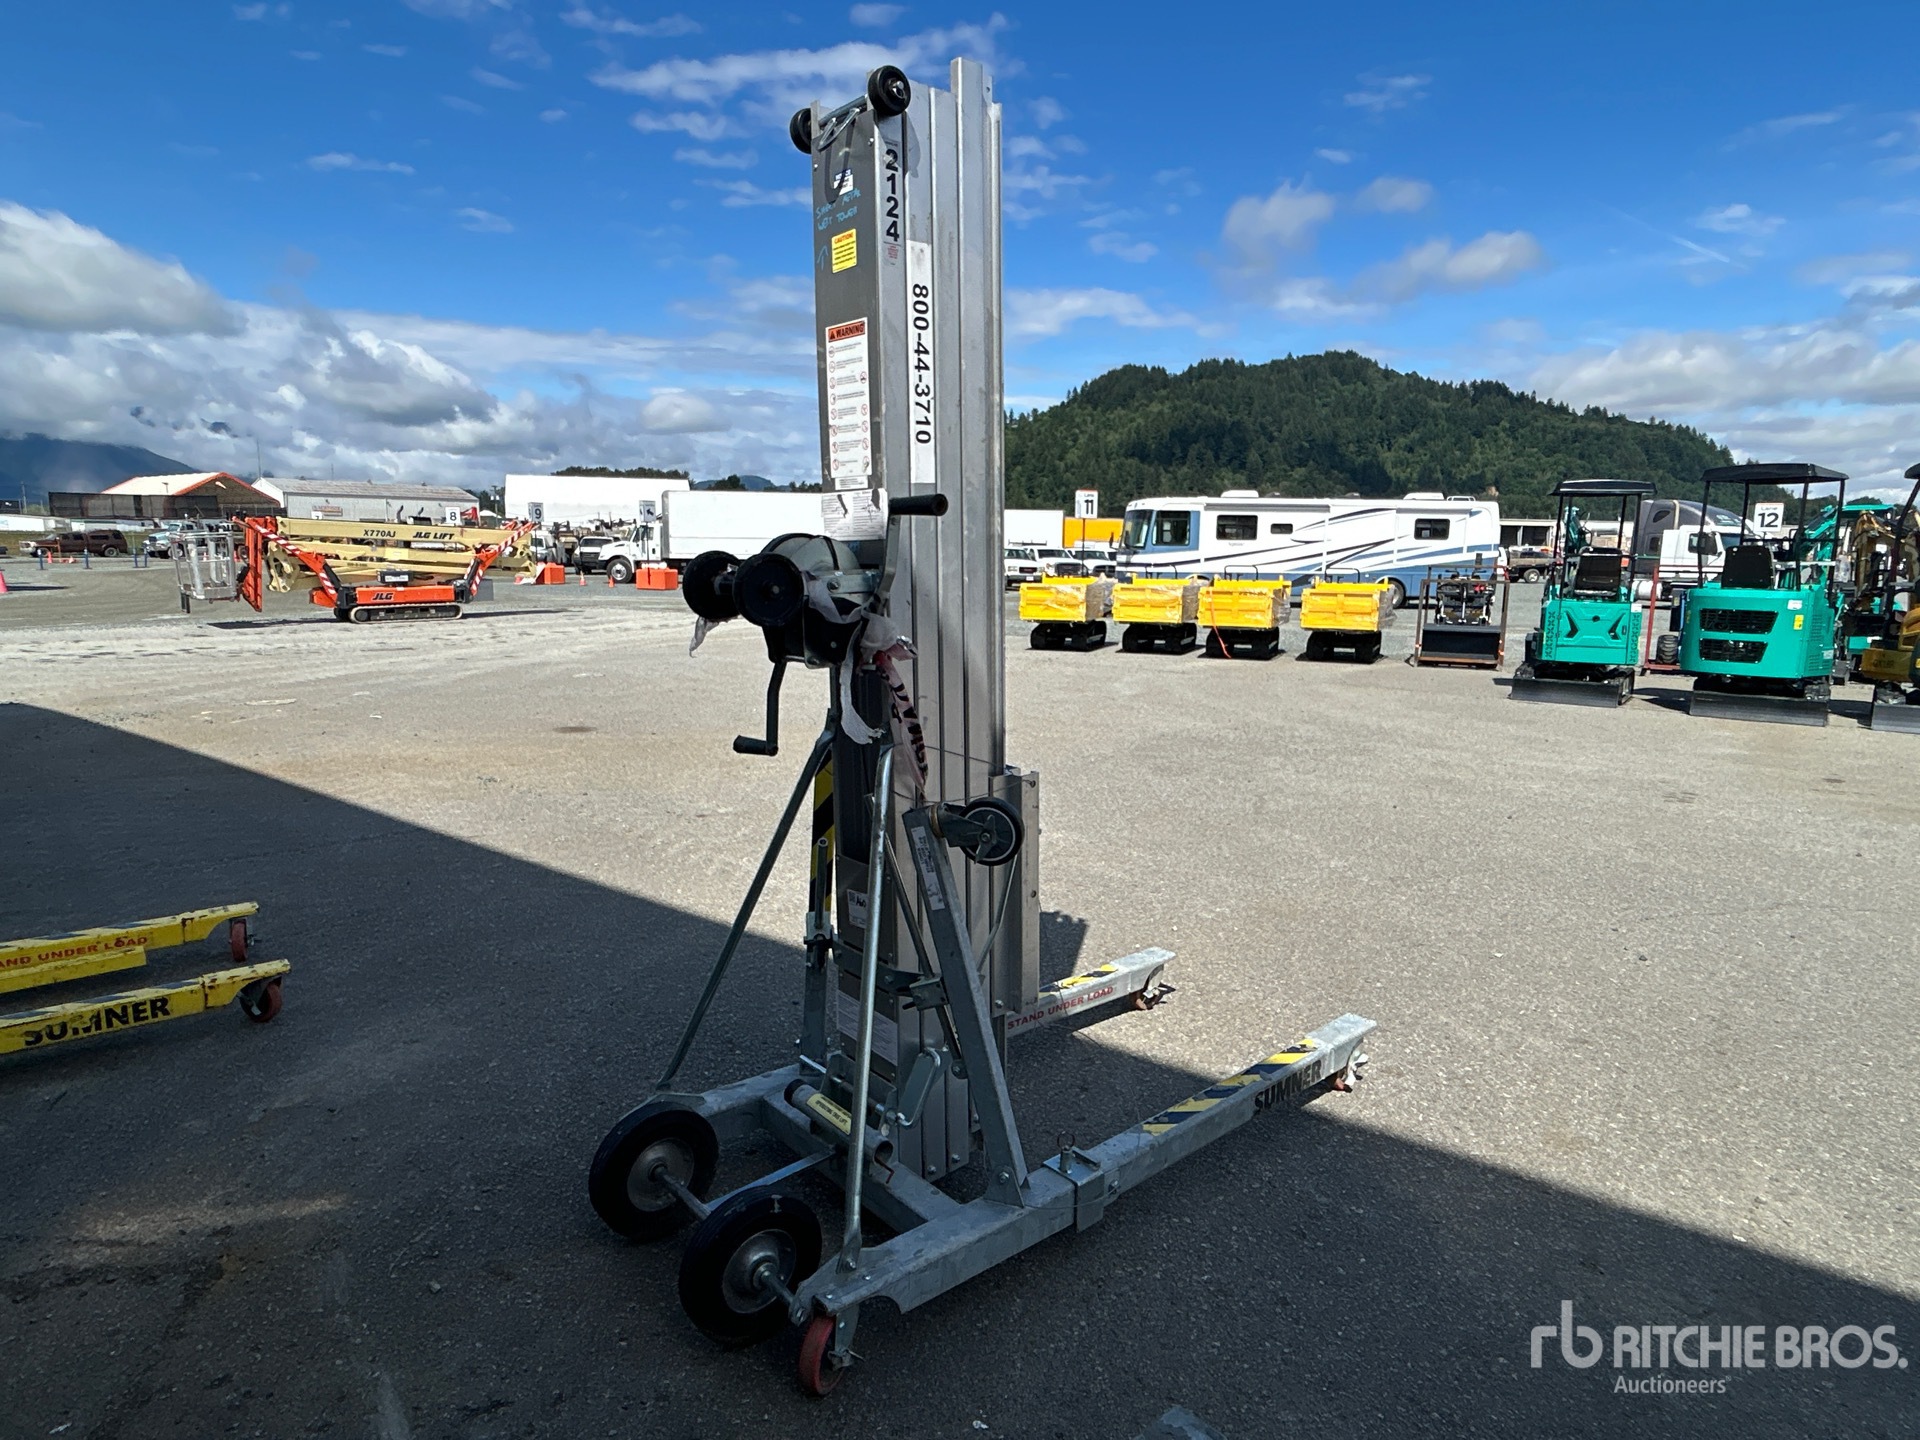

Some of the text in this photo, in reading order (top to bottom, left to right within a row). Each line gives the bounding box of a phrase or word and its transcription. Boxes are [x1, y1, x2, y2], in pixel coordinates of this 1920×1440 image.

[885, 148, 900, 242] 2124
[836, 323, 865, 338] WARNING
[912, 283, 932, 444] 800-44-3710
[534, 508, 542, 519] 9
[1084, 499, 1094, 515] 11
[449, 511, 458, 521] 8
[1757, 512, 1779, 528] 12
[363, 529, 397, 538] X770AJ
[412, 531, 455, 540] JLG LIFT
[372, 592, 394, 601] JLG
[38, 944, 98, 962] UNDER
[103, 935, 148, 950] LOAD
[1007, 986, 1114, 1030] STAND UNDER LOAD
[24, 996, 171, 1046] SUMNER
[1254, 1060, 1322, 1109] SUMNER
